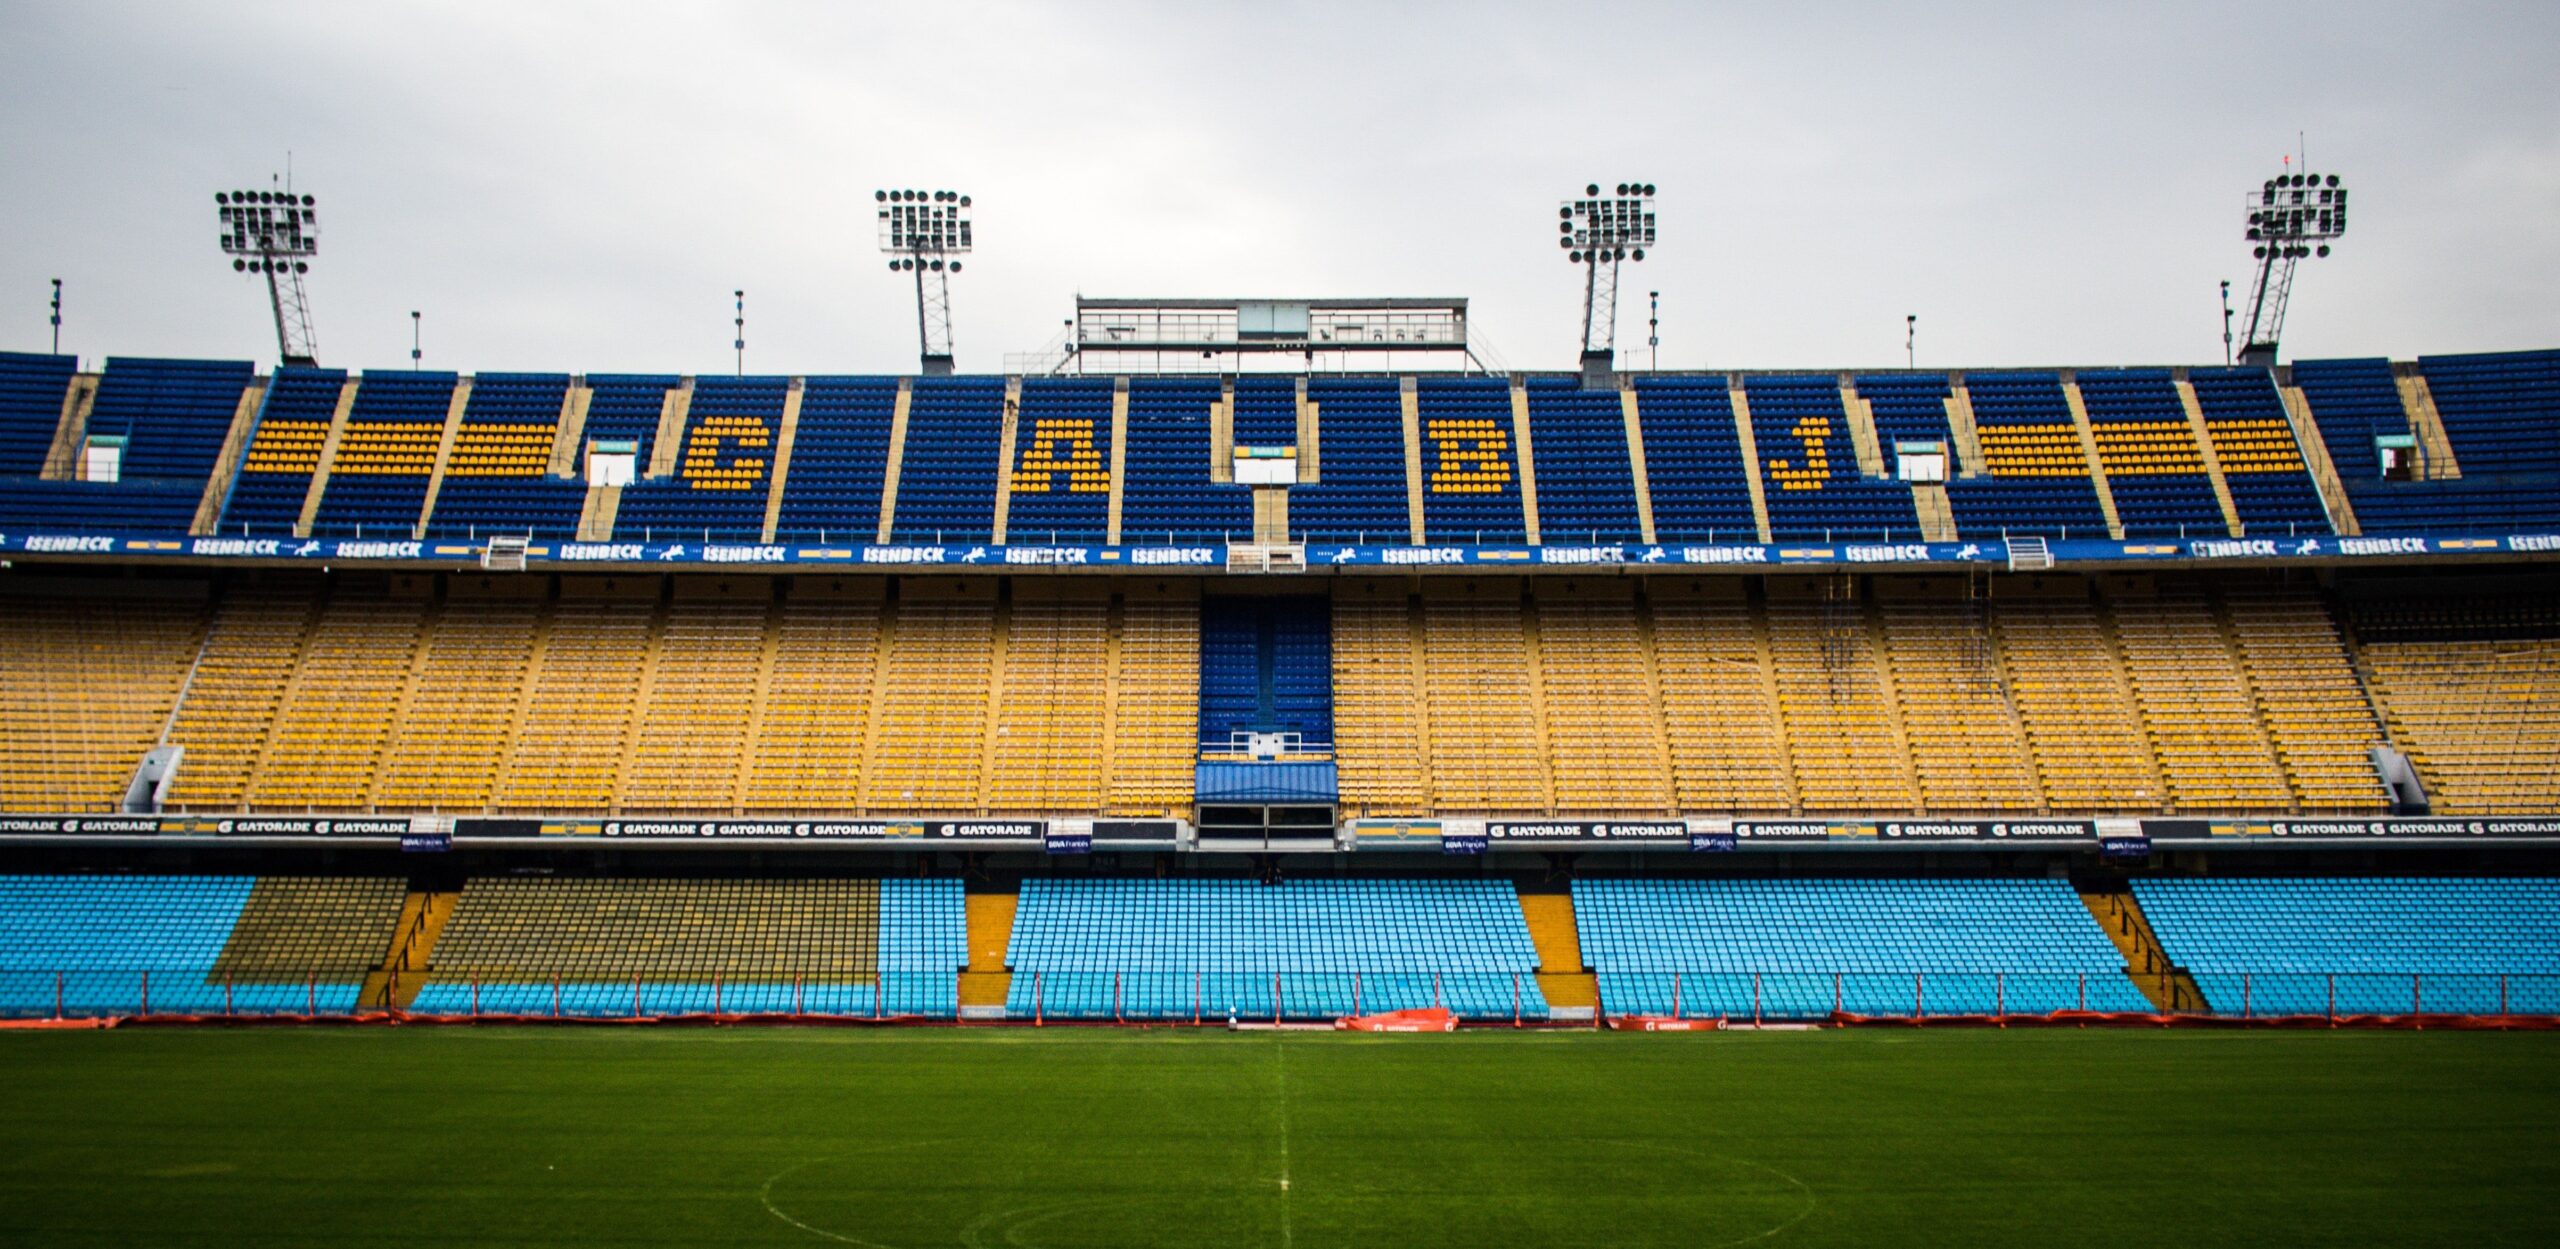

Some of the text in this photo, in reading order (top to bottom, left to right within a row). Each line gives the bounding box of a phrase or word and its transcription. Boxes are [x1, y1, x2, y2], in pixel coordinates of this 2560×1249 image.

[682, 416, 1831, 494] C A B J
[25, 536, 113, 551] ISENBECK
[193, 540, 278, 554] ISENBECK
[337, 543, 422, 557] ISENBECK
[2190, 540, 2278, 557] ISENBECK
[2339, 538, 2426, 555] ISENBECK
[560, 544, 644, 560] ISENBECK
[703, 546, 786, 561] ISENBECK
[863, 547, 945, 562] ISENBECK
[1005, 548, 1088, 564] ISENBECK
[1132, 548, 1213, 564] ISENBECK
[1382, 548, 1464, 564] ISENBECK
[1541, 547, 1625, 563] ISENBECK
[1684, 548, 1766, 562] ISENBECK
[1846, 546, 1929, 562] ISENBECK
[82, 822, 156, 830] GATORADE
[237, 822, 310, 831] GATORADE
[334, 823, 406, 832] GATORADE
[624, 824, 696, 834] GATORADE
[719, 825, 791, 834] GATORADE
[814, 825, 887, 835] GATORADE
[960, 825, 1031, 835] GATORADE
[1509, 826, 1581, 836] GATORADE
[1611, 826, 1683, 836] GATORADE
[1755, 826, 1827, 835] GATORADE
[1905, 825, 1978, 835] GATORADE
[2012, 825, 2084, 835] GATORADE
[2292, 825, 2366, 834] GATORADE
[2390, 824, 2465, 833] GATORADE
